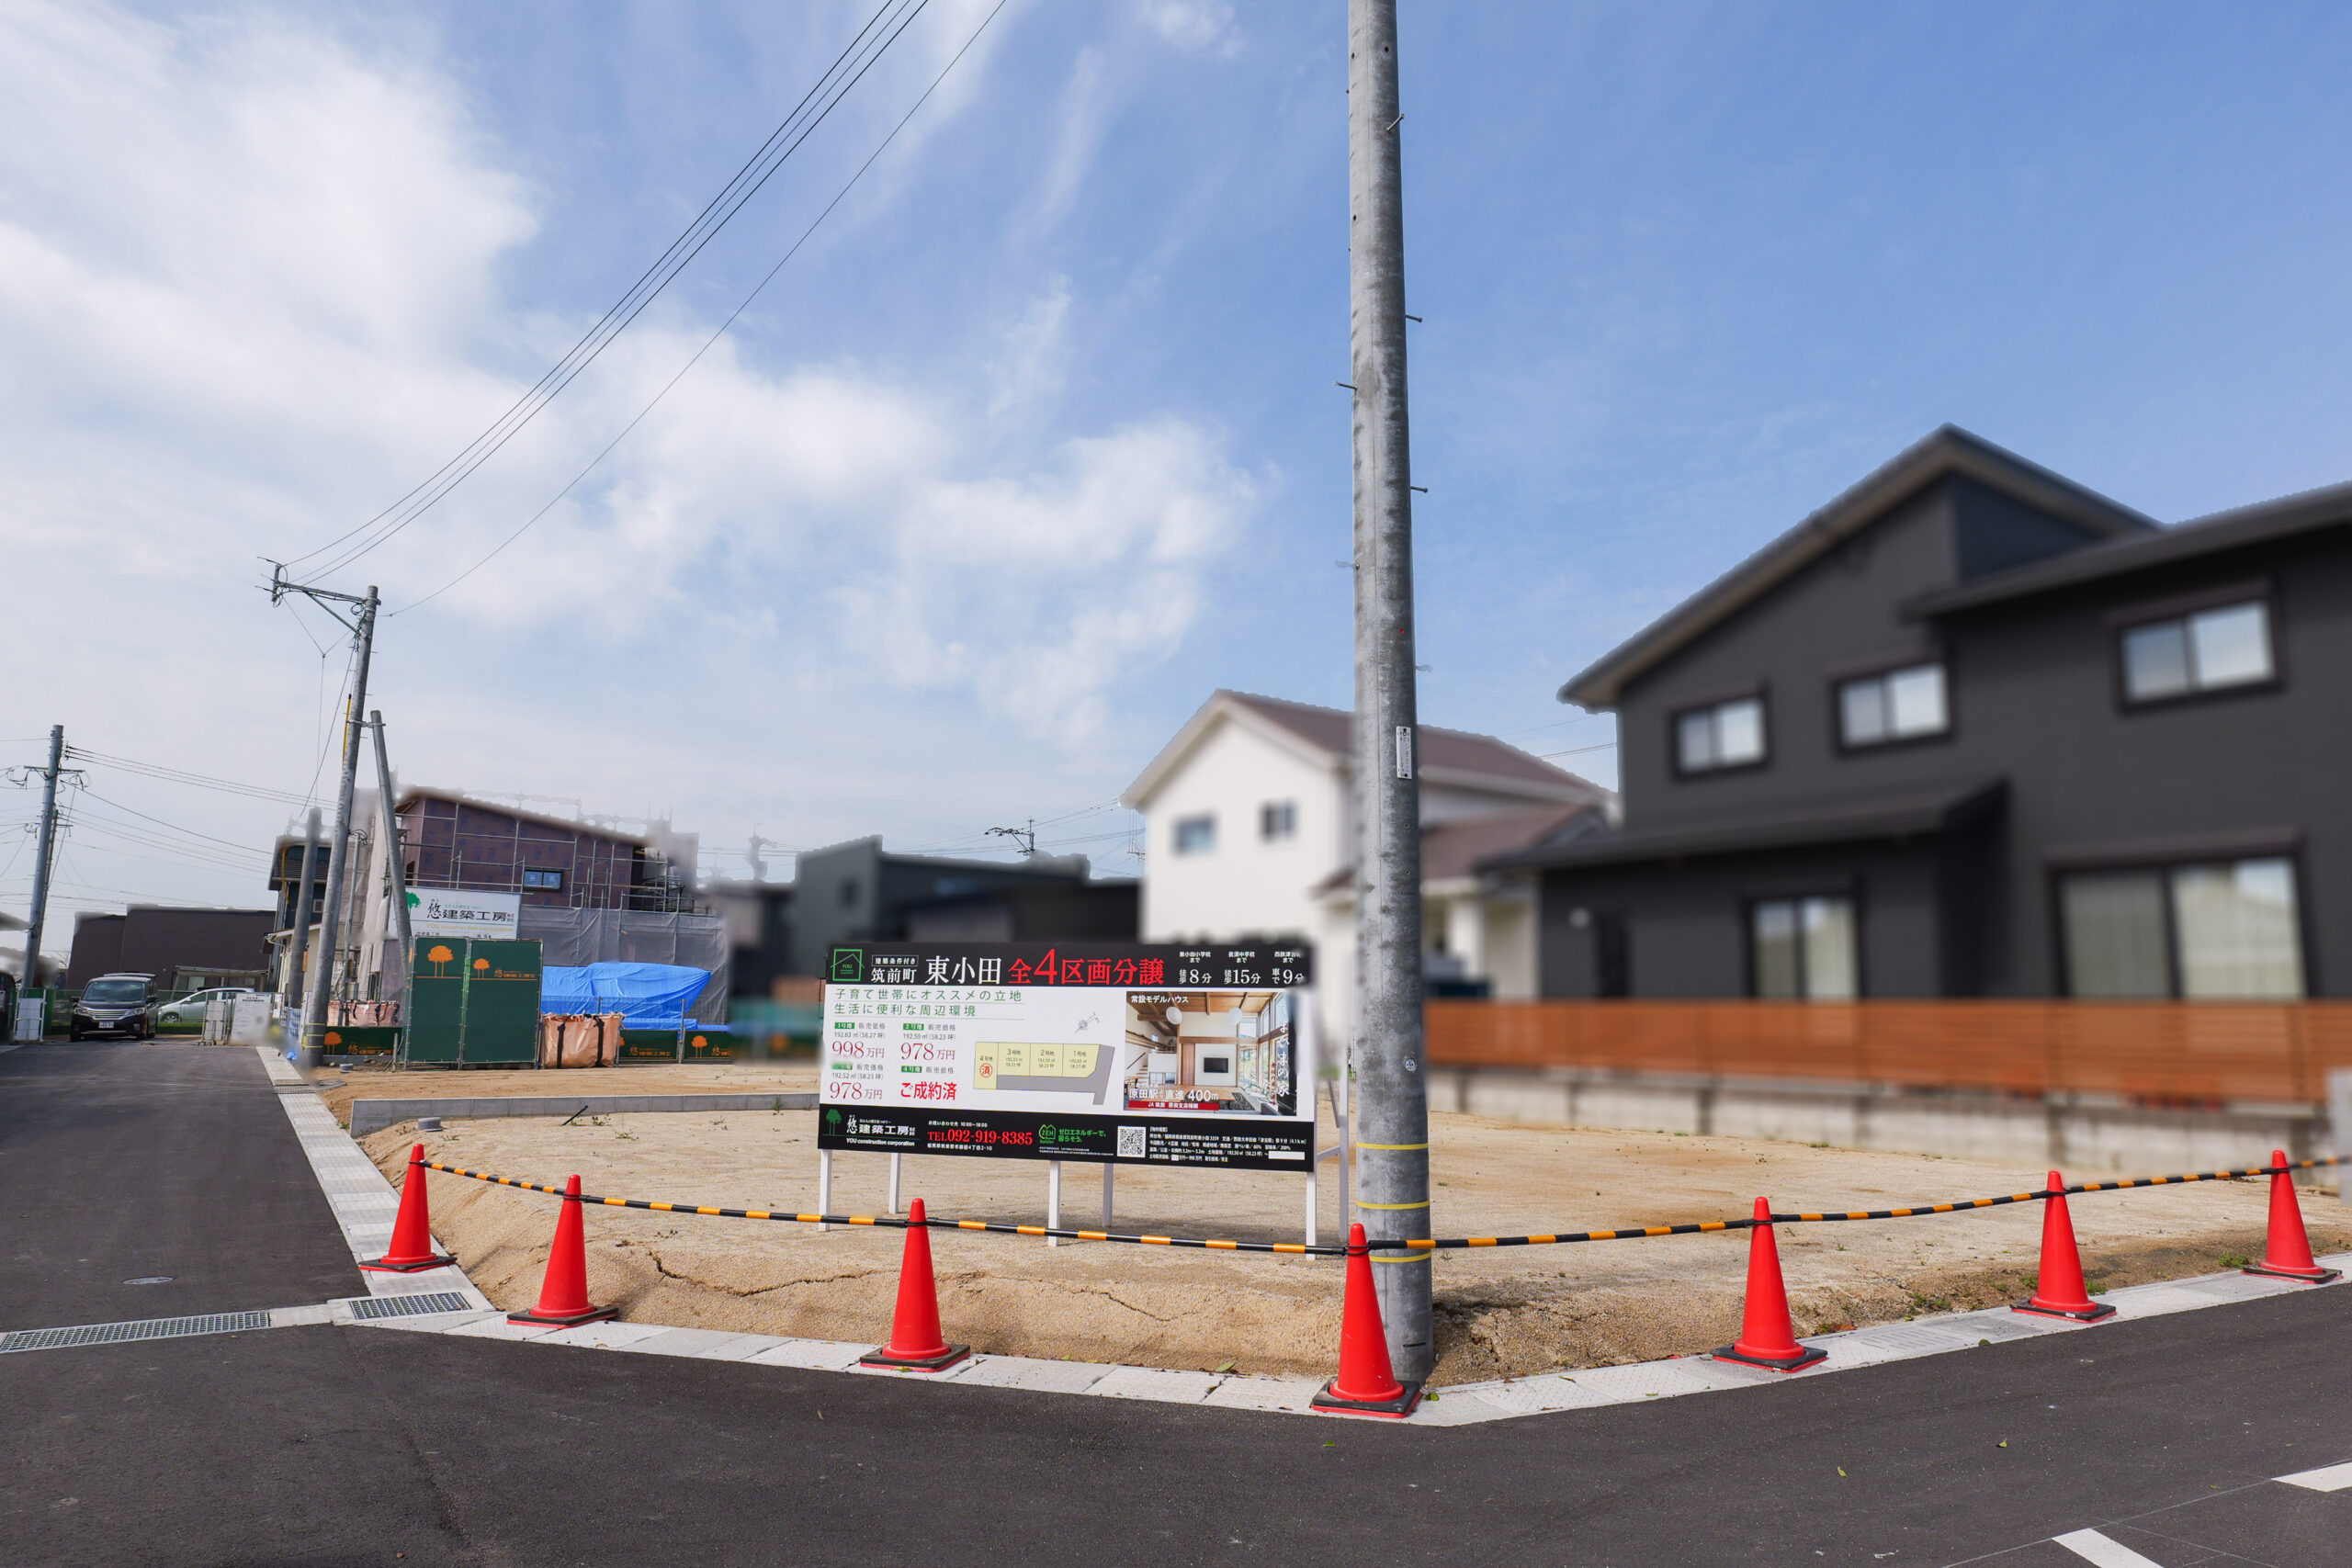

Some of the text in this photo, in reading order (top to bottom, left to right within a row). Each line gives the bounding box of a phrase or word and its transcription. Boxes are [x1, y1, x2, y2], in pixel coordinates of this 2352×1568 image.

[871, 948, 1165, 985] 筑前町 東小田 全4区画分譲
[875, 957, 916, 965] 建築条件付き
[834, 988, 1022, 1002] 子育て世帯にオススメの立地
[1130, 995, 1189, 1004] 常設モデルハウス
[833, 1003, 977, 1017] 生活に便利な周辺環境
[900, 1080, 957, 1100] ご成約済
